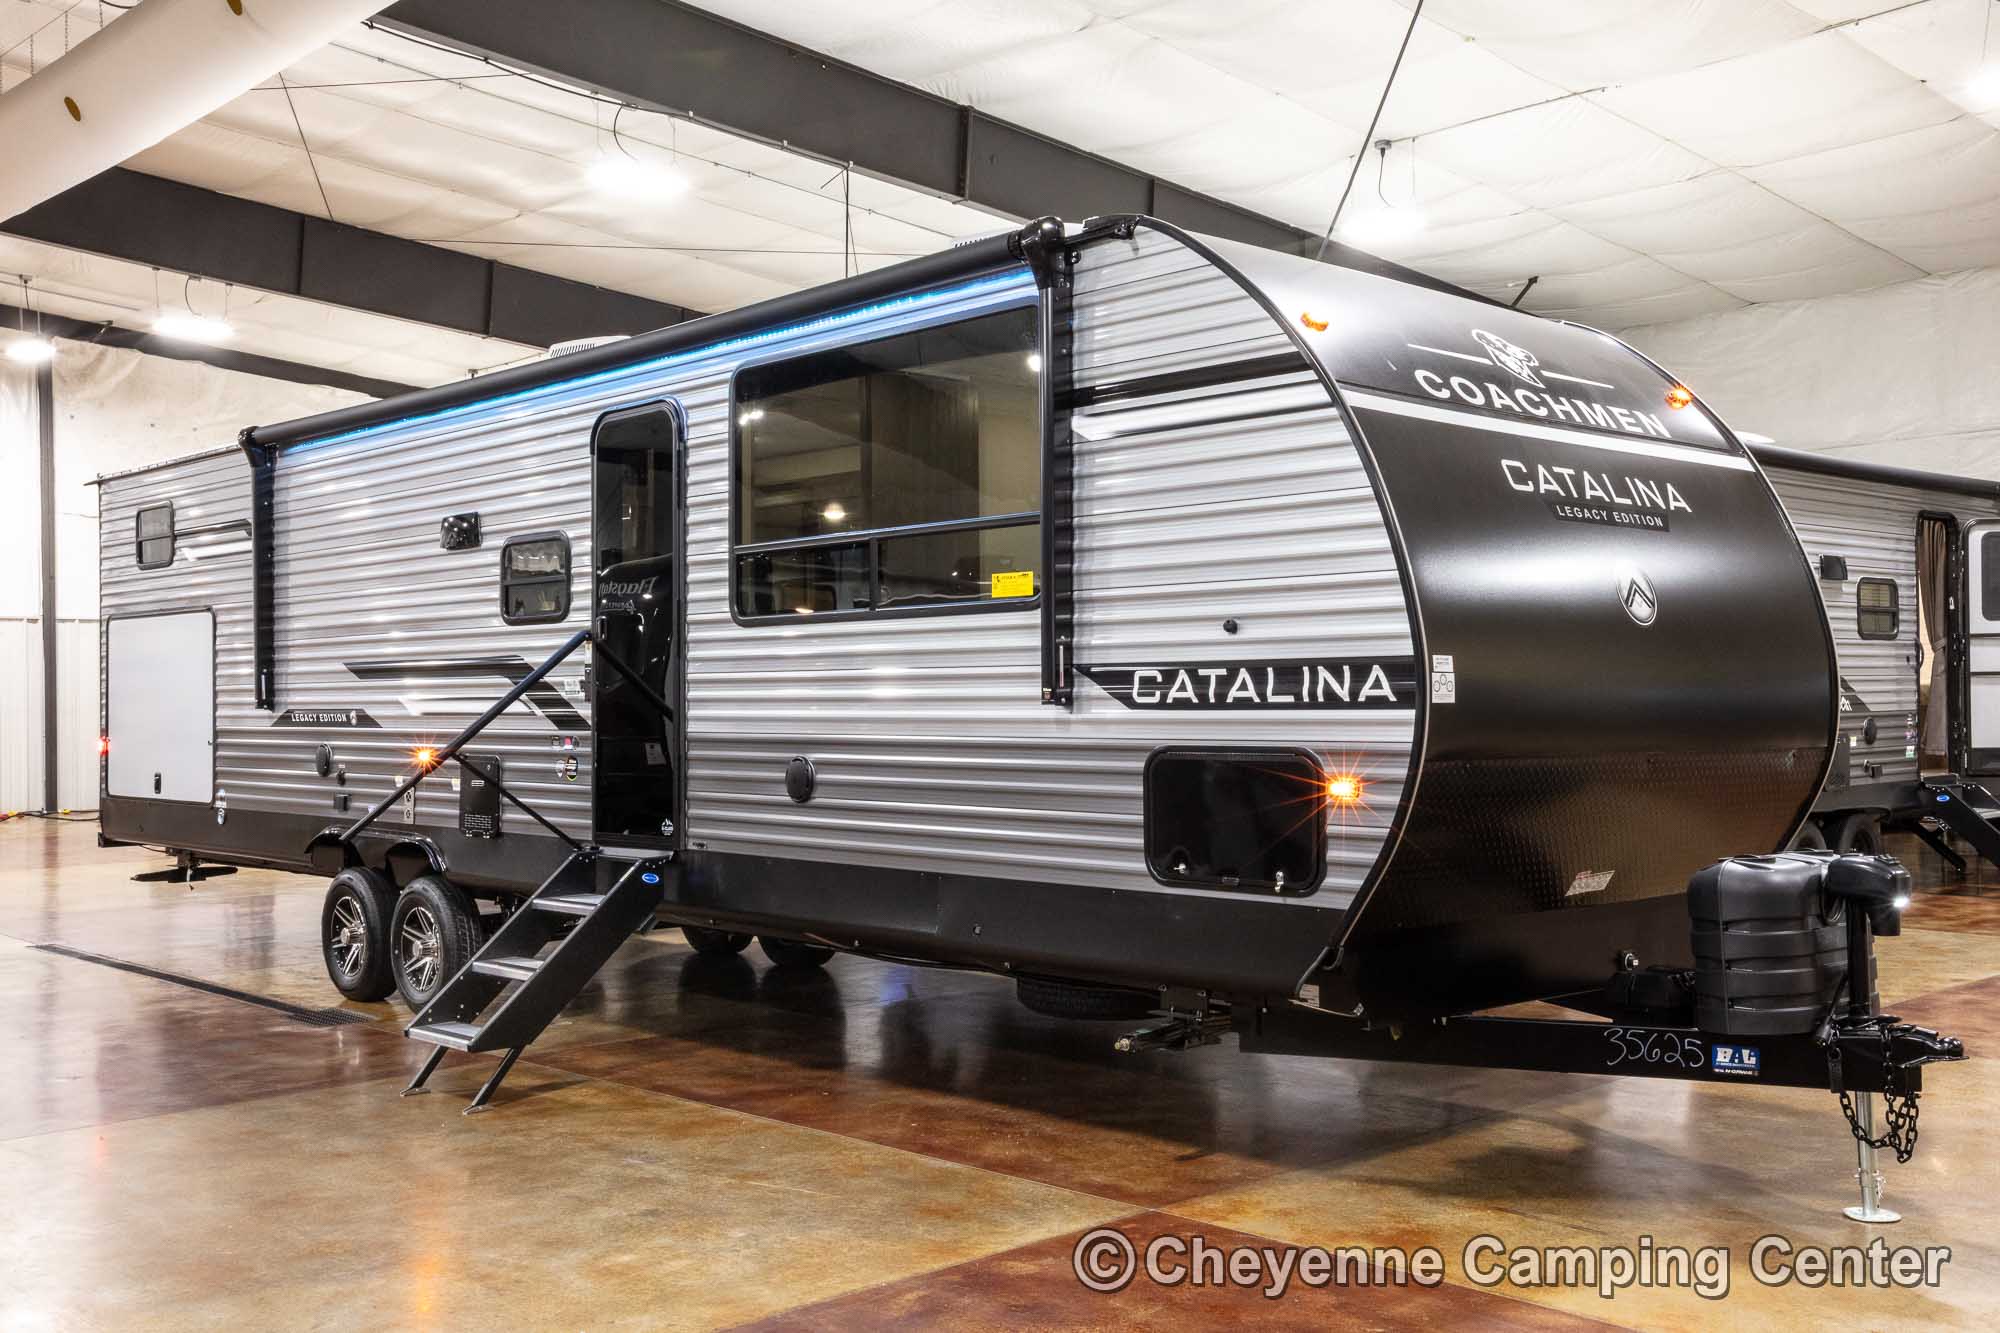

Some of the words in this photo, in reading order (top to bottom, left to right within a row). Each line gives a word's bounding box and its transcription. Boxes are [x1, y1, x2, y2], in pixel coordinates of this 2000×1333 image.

[1414, 369, 1672, 439] COACHMEN
[1501, 458, 1692, 513] CATALINA
[1556, 504, 1608, 521] LEGACY
[1613, 511, 1664, 527] EDITION
[1131, 664, 1398, 704] CATALINA
[291, 713, 317, 722] LEGACY
[319, 713, 347, 722] EDITION
[1603, 1027, 1705, 1068] 35625
